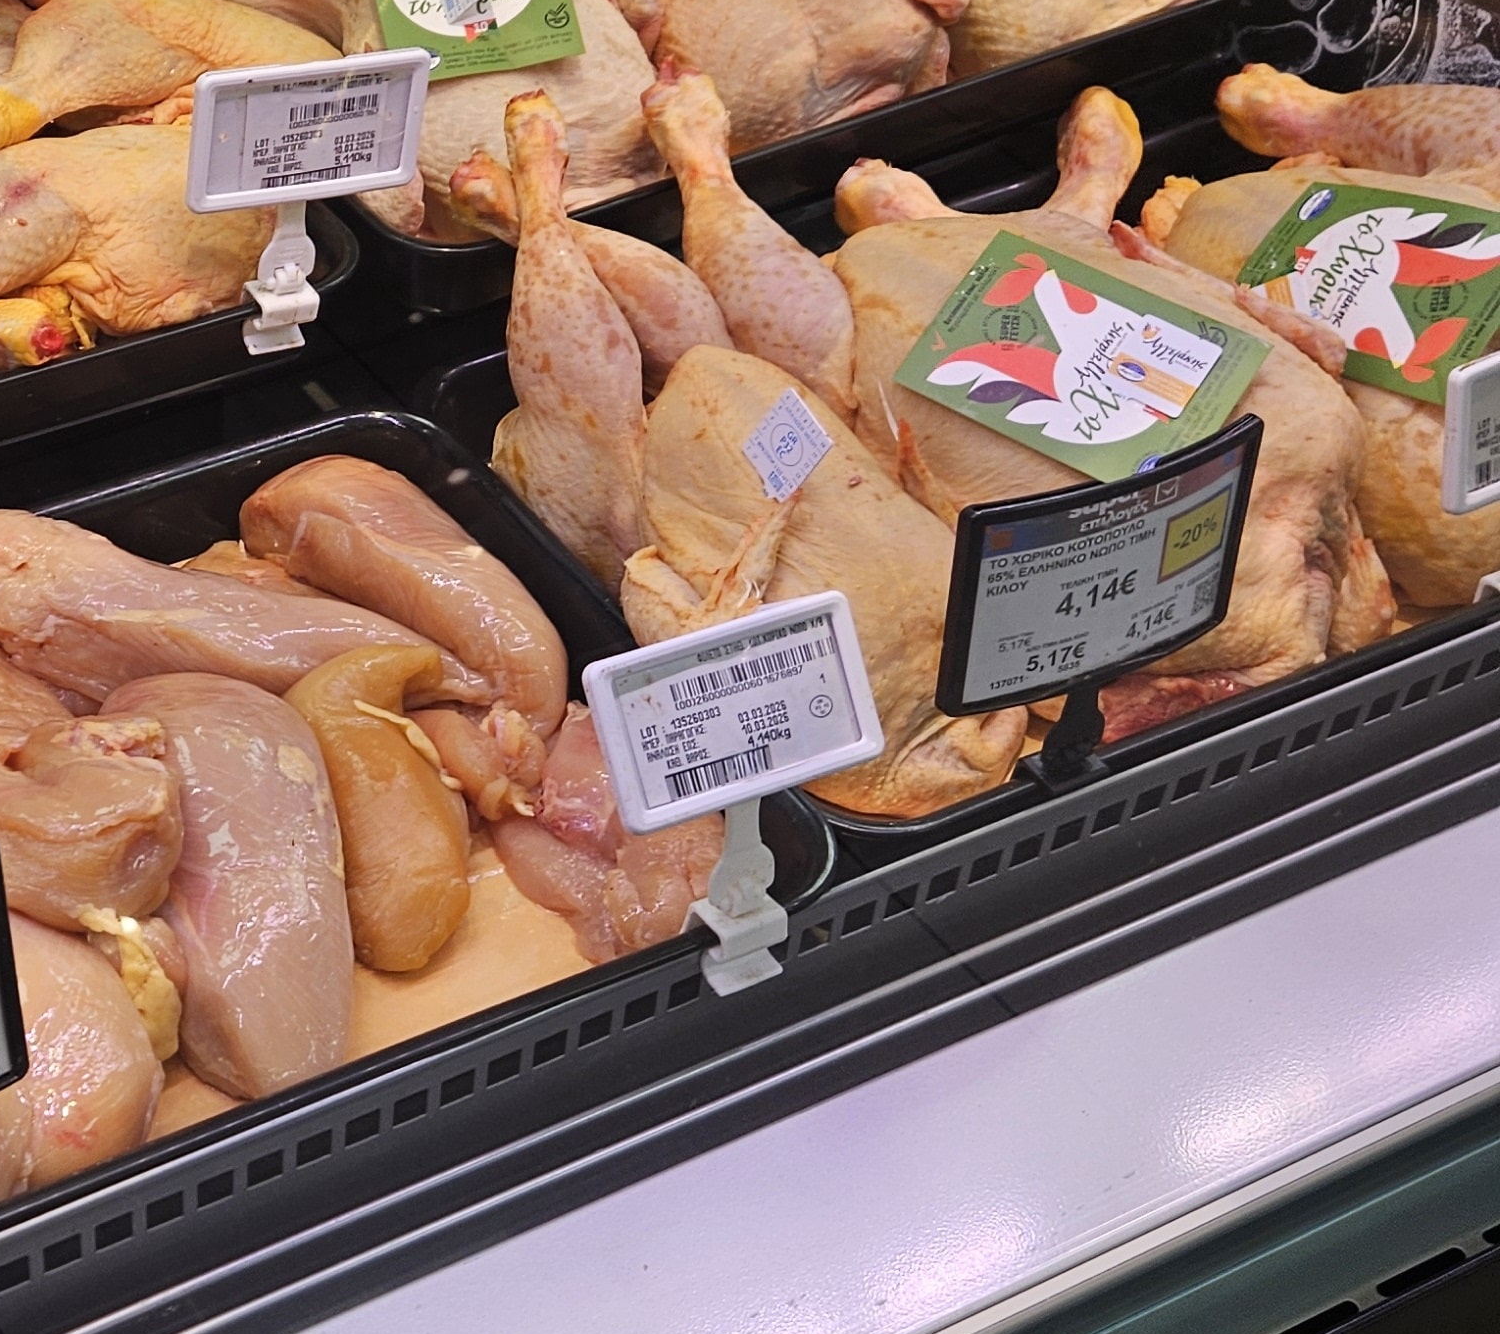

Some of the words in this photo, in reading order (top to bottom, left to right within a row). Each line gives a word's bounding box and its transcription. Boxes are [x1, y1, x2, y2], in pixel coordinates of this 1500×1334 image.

[334, 130, 376, 145] 03.03.2026
[1309, 236, 1386, 312] Χωρικ
[1079, 499, 1149, 533] επιλογές
[990, 557, 1008, 570] ΤΟ
[1011, 545, 1065, 566] ΧΩΡΙΚΟ
[1067, 520, 1145, 554] ΚΟΤΟΠΟΥΛΟ
[1173, 519, 1218, 550] -20%
[987, 570, 1015, 584] 65%
[1017, 553, 1087, 579] ΕΛΛΗΝΙΚΟ
[1089, 539, 1127, 559] ΝΩΠΟ
[1128, 527, 1157, 546] ΤΙΜΗ
[986, 581, 1029, 598] ΚΙΛΟΥ
[1055, 569, 1139, 617] 4,14€
[1060, 574, 1095, 590] ΤΕΛΙΚΗ
[1096, 567, 1119, 582] ΤΙΜΗ
[1125, 603, 1176, 639] 4,14€
[1026, 641, 1087, 672] 5,17€
[989, 675, 1025, 690] 137071
[639, 726, 657, 740] LOT
[670, 706, 722, 730] 135260303
[737, 699, 787, 724] 03.03.2026
[741, 711, 790, 736] 10.03.2026
